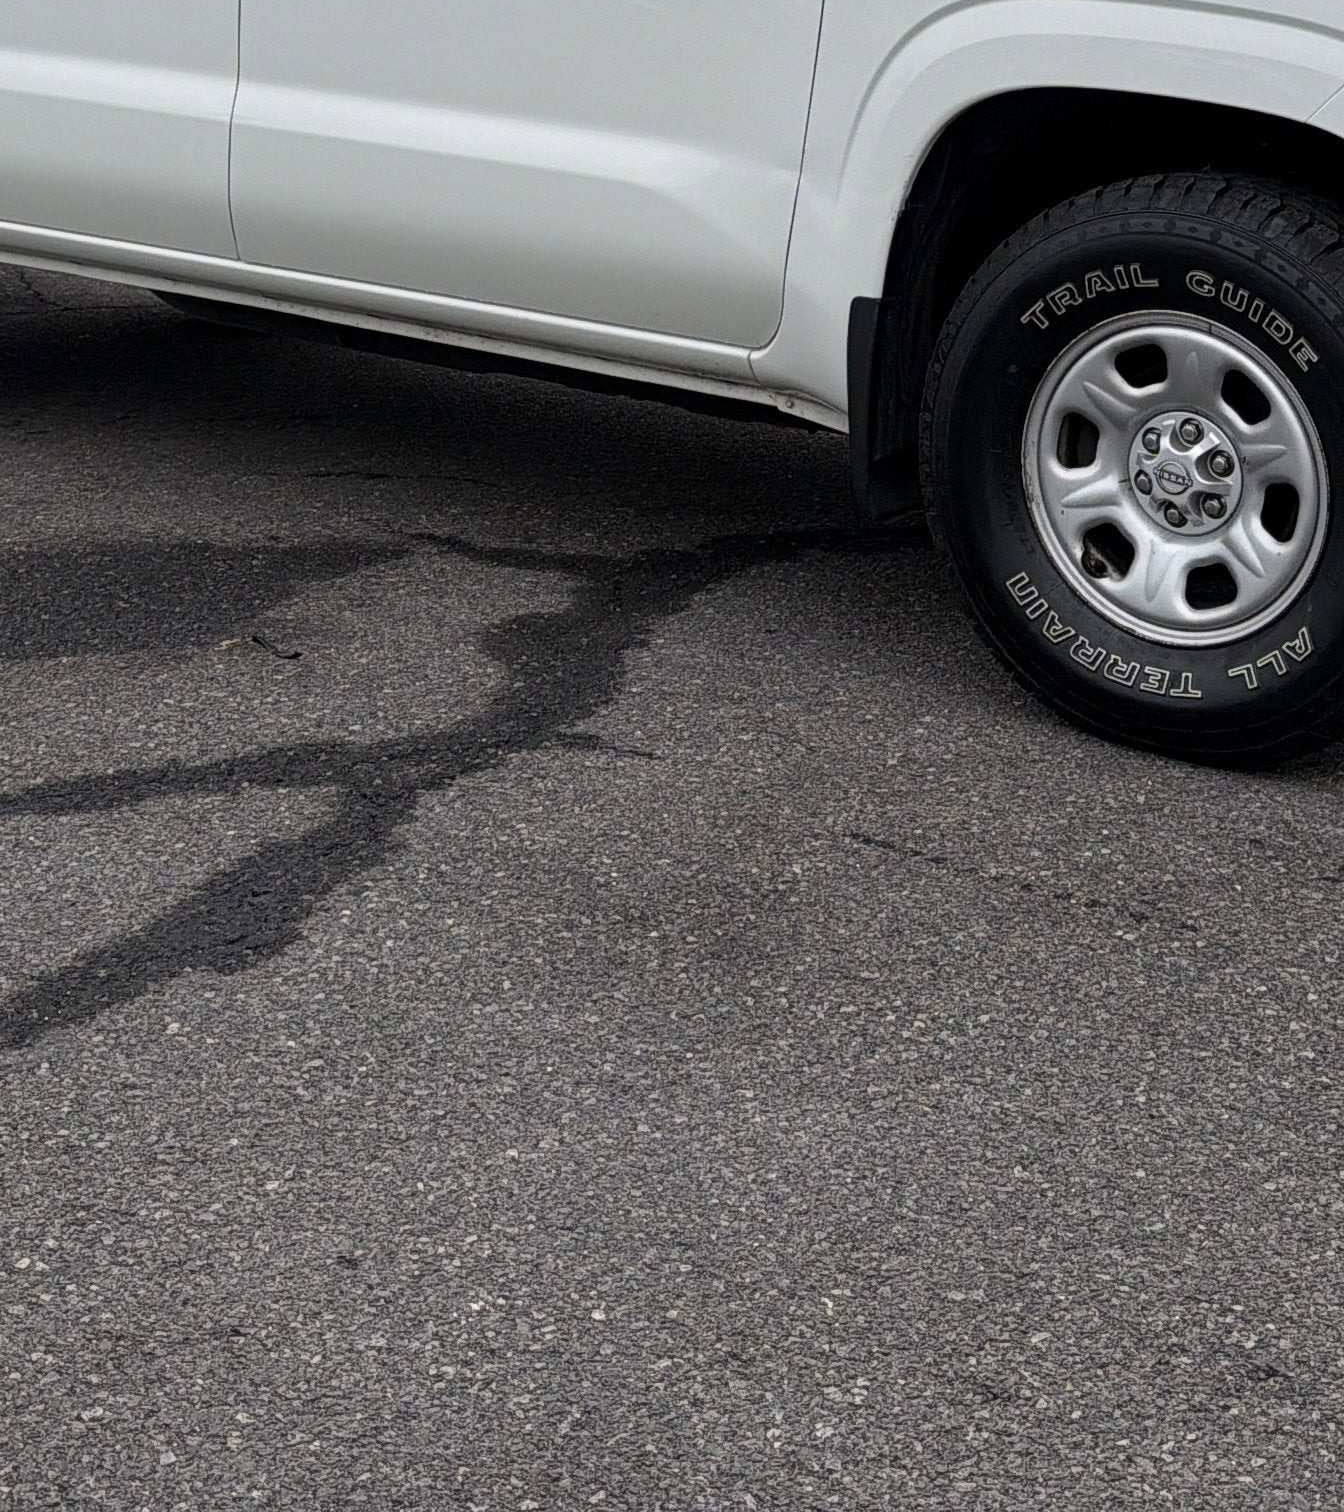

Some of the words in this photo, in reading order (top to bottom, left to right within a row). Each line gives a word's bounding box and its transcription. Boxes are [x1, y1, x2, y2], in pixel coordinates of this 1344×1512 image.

[1020, 263, 1159, 330] TRAIL
[1186, 270, 1319, 373] GUIDE
[1006, 571, 1202, 698] TERRAIN
[1228, 626, 1314, 690] ALL
